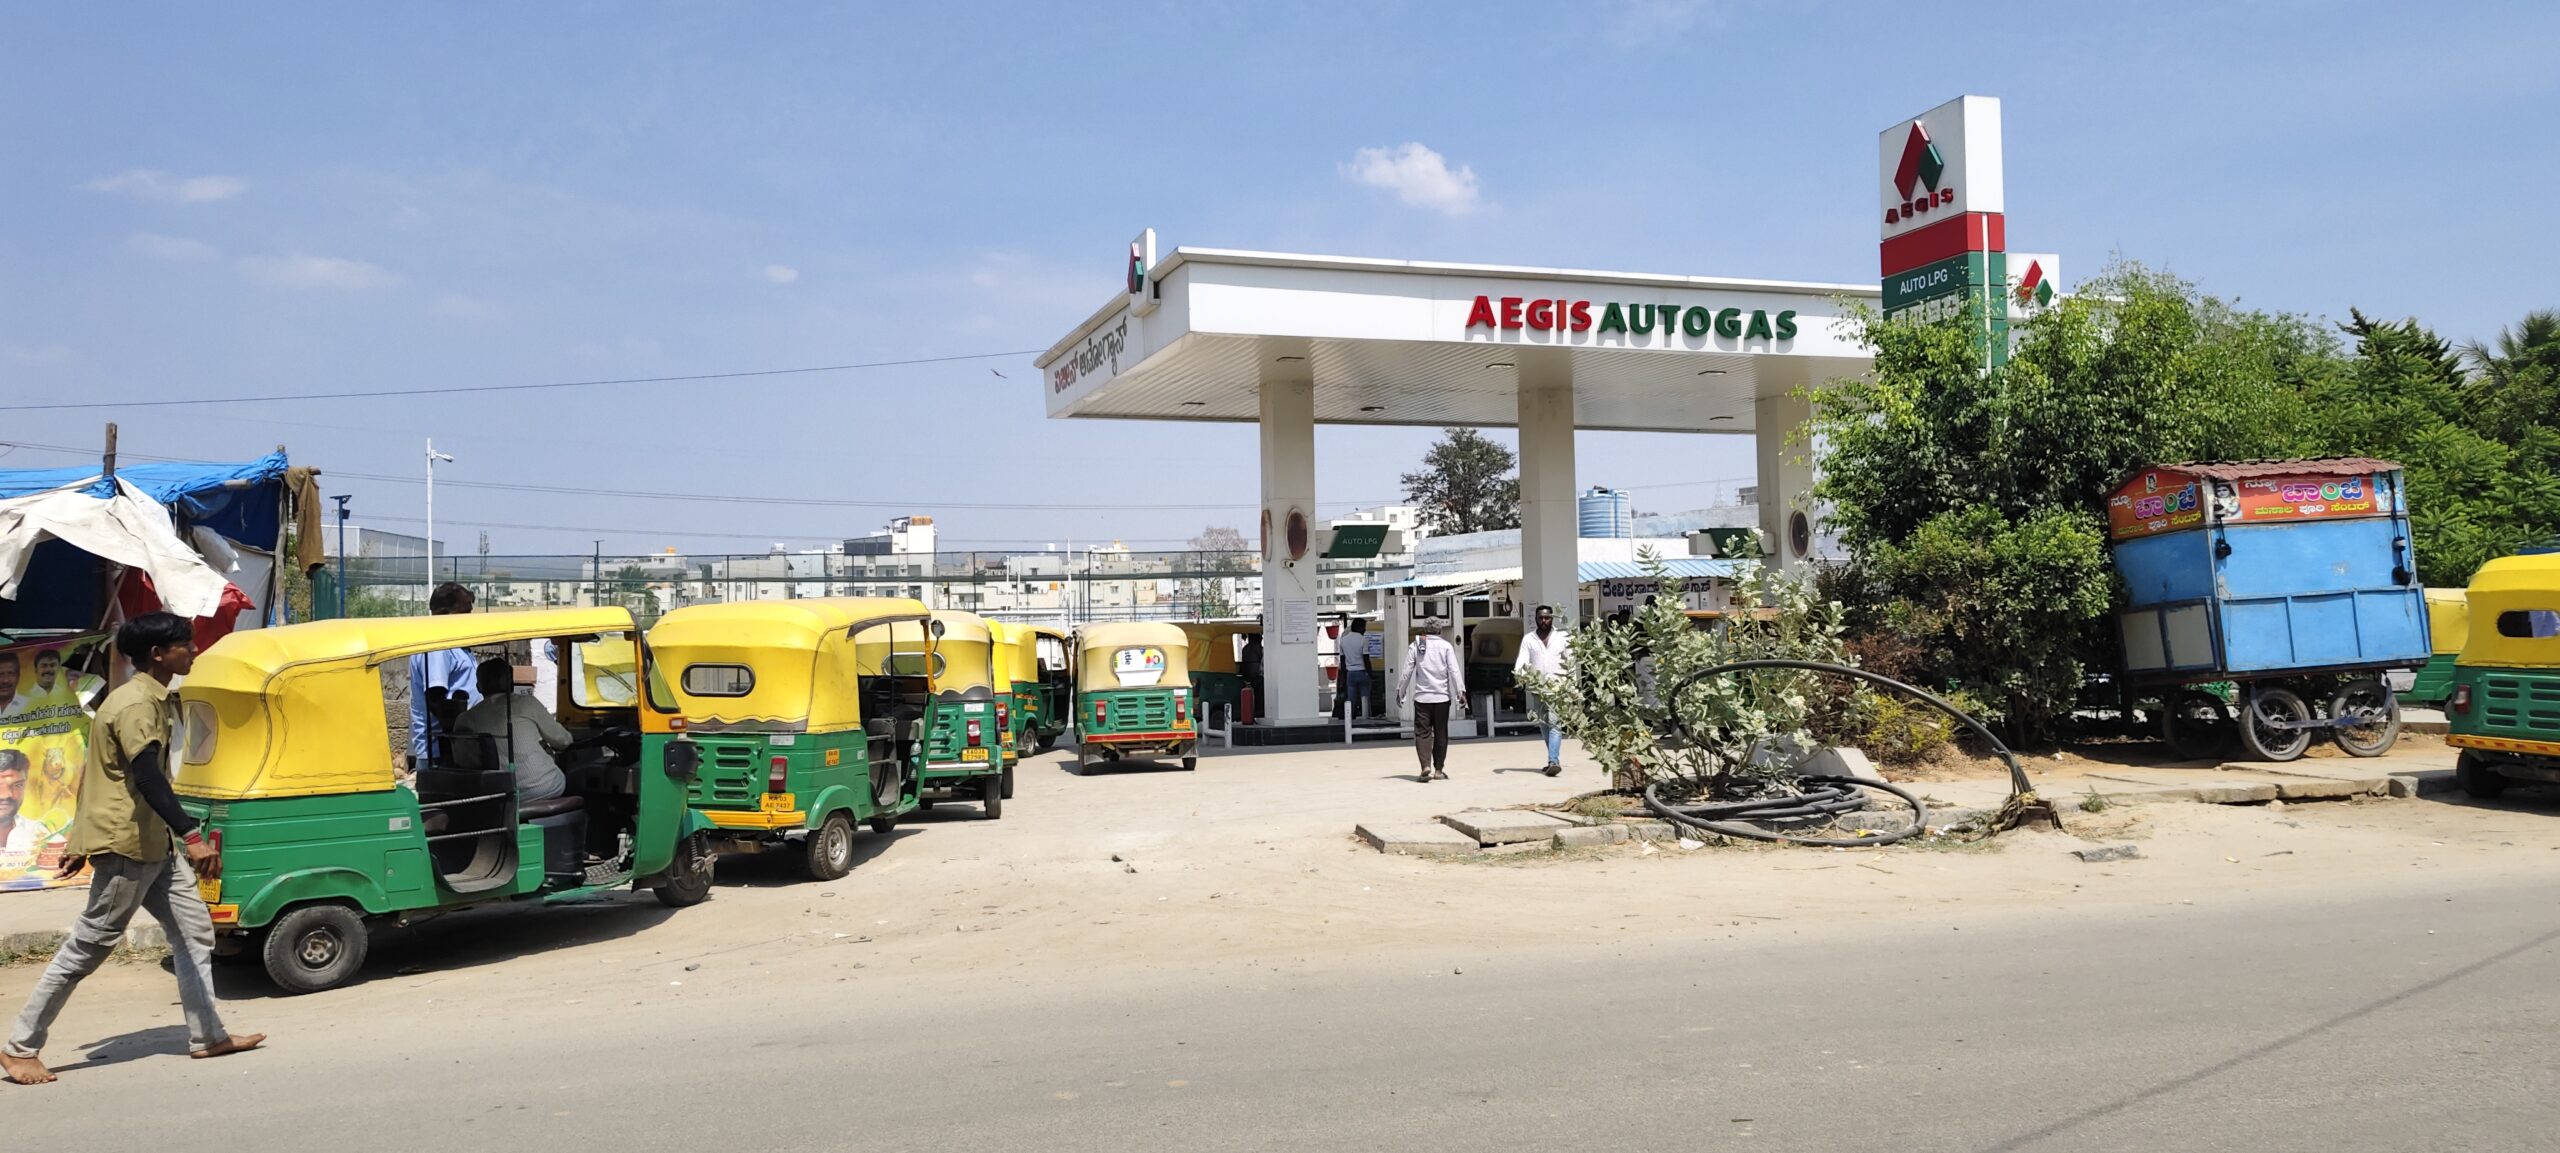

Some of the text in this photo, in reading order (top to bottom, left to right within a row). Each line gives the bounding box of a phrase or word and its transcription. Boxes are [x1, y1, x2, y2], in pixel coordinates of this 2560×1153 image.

[1885, 188, 1954, 224] AEGIS
[1900, 268, 1948, 295] AUTO LPG
[1466, 295, 1797, 340] AEGIS AUTOGAS
[1342, 537, 1378, 545] AUTO LPG
